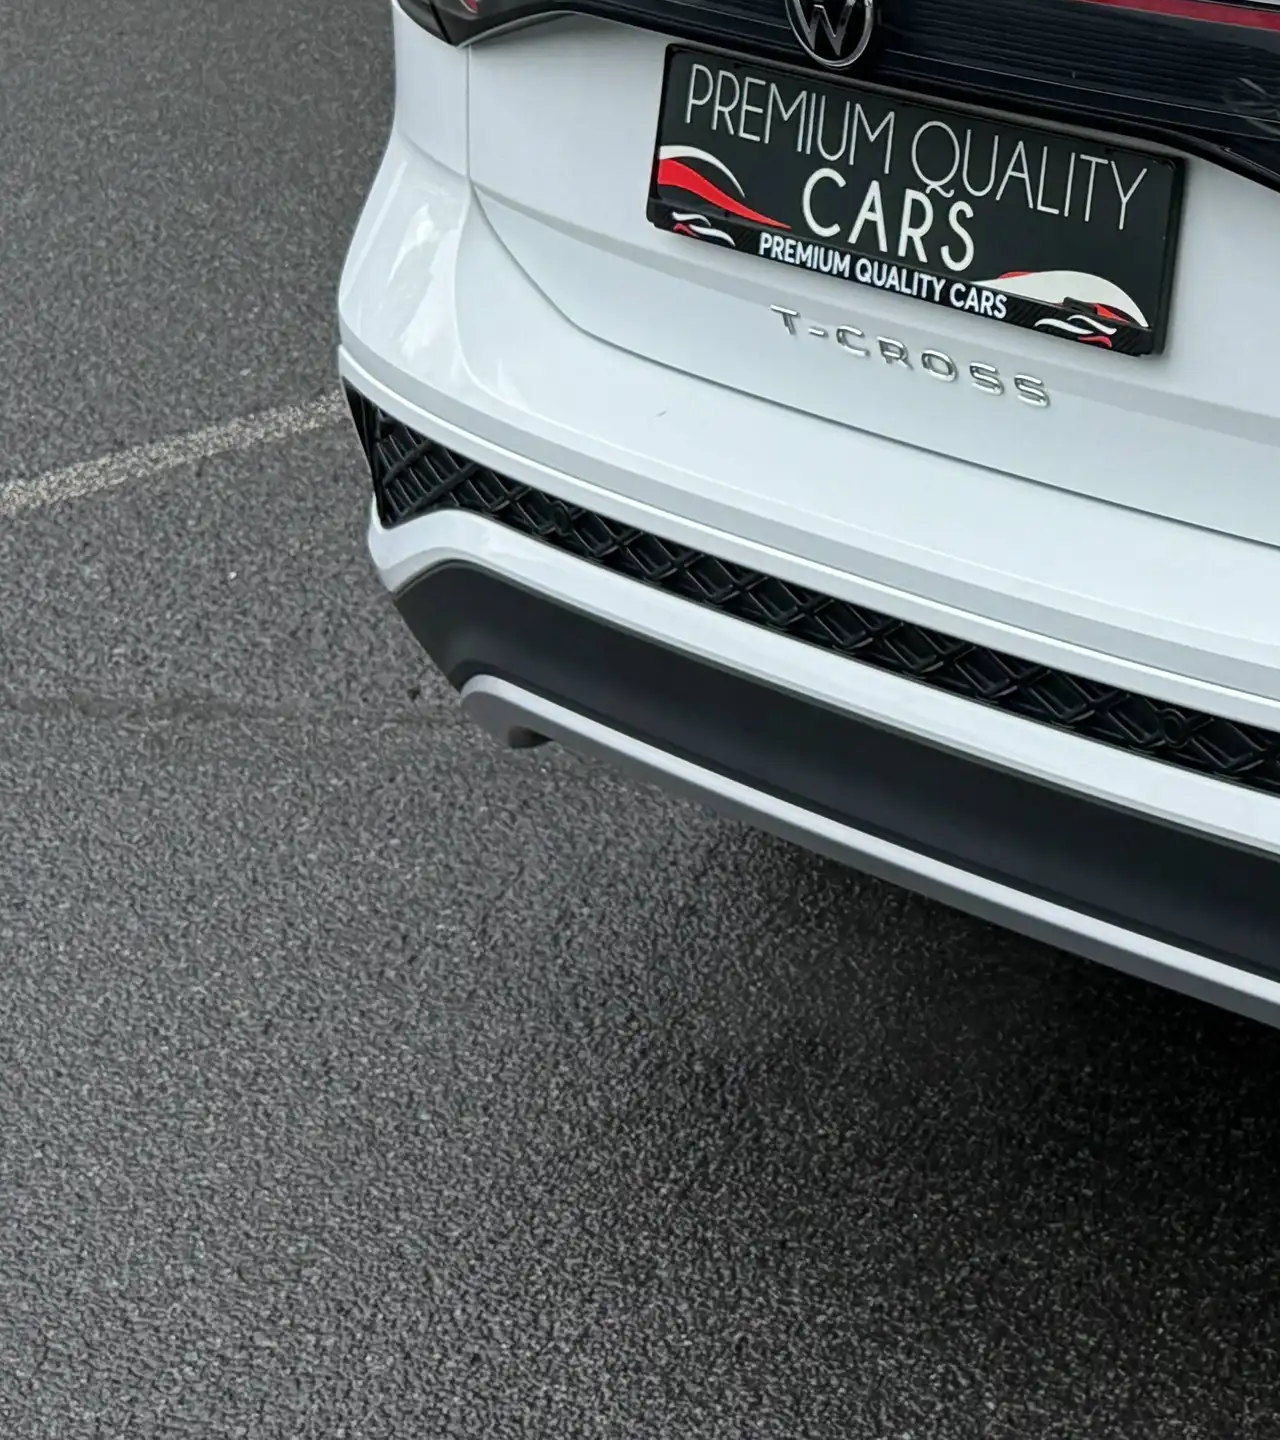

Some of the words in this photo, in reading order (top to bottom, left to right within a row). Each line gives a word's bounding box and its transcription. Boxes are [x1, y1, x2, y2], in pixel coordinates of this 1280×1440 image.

[684, 62, 896, 176] PREMIUM
[910, 120, 1149, 232] QUALITY
[801, 166, 976, 273] CARS
[758, 231, 852, 280] PREMIUM
[854, 257, 947, 305] QUALITY
[949, 282, 1009, 320] CARS
[769, 304, 1052, 409] T-CROSS
